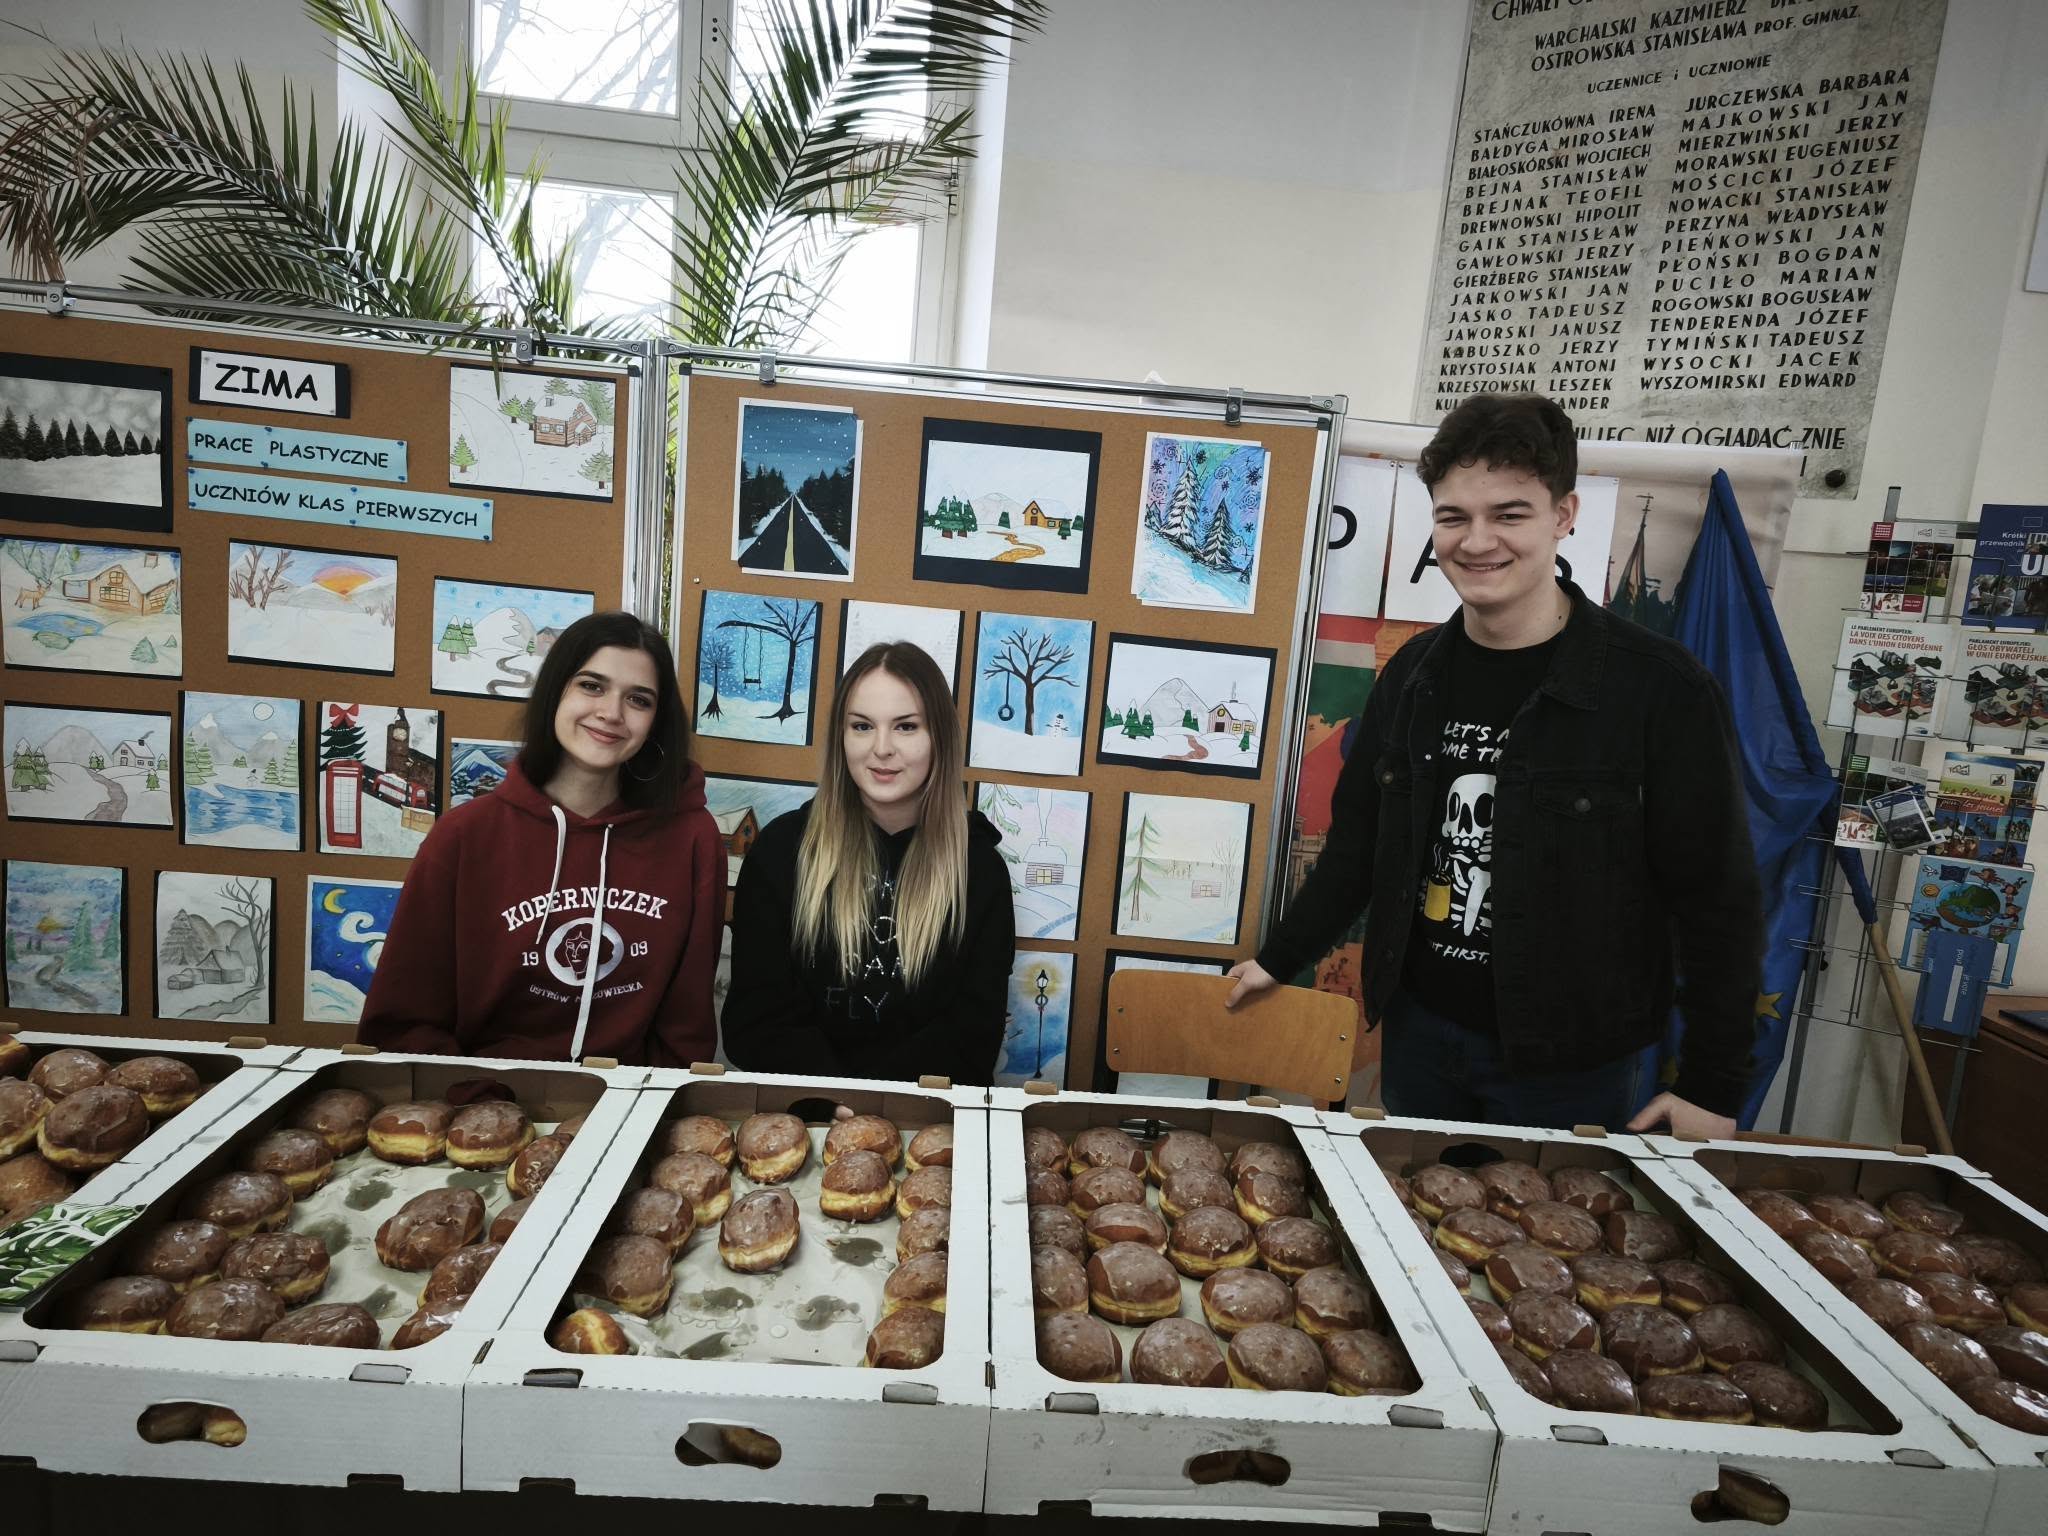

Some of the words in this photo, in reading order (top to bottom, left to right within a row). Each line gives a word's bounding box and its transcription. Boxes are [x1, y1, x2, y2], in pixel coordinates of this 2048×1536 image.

[1531, 39, 1634, 71] OSTROWSKA
[1643, 20, 1747, 53] STANISŁAWA
[1754, 17, 1796, 34] PROF.
[1802, 5, 1861, 26] GIMNAZ.
[1535, 16, 1637, 50] WARCHALSKI
[1650, 0, 1747, 30] KAZIMIERZ
[1588, 71, 1662, 93] UCZENNICE
[1689, 54, 1772, 77] UCZNIOWIE
[1685, 83, 1804, 112] JURCZEWSKA
[1819, 67, 1910, 94] BARBARA
[1474, 113, 1595, 144] STAŃCZUKÓWNA
[1609, 104, 1656, 123] IRENA
[1681, 100, 1829, 132] MAJKOWSKI
[1858, 90, 1908, 110] JAN
[1471, 139, 1548, 162] BAŁDYGA
[1559, 124, 1655, 149] MIROSŁAW
[1678, 123, 1809, 153] MIERZWIŃSKI
[1835, 112, 1904, 134] JERZY
[1468, 155, 1569, 181] BIAŁOSKÓRSKI
[1576, 143, 1652, 166] WOJCIECH
[1674, 148, 1777, 173] MORAWSKI
[1785, 134, 1900, 161] EUGENIUSZ
[1466, 180, 1521, 198] BEJNA
[1540, 164, 1648, 189] STANISŁAW
[1671, 167, 1792, 194] MOŚCICKI
[1812, 156, 1897, 179] JÓZEF
[1463, 195, 1549, 217] BREJNAK
[1566, 184, 1643, 205] TEOFIL
[1668, 191, 1761, 214] NOWACKI
[1775, 178, 1892, 204] STANISŁAW
[1460, 212, 1562, 235] DREWNOWSKI
[1576, 204, 1641, 223] HIPOLIT
[1665, 213, 1749, 234] PERZYNA
[1767, 200, 1888, 225] WŁADYSŁAW
[1459, 236, 1506, 252] GAIK
[1517, 223, 1638, 247] STANISŁAW
[1662, 227, 1813, 254] PIEŃKOWSKI
[1836, 221, 1885, 240] JAN
[1456, 249, 1563, 270] GAWŁOWSKI
[1575, 243, 1634, 261] JERZY
[1658, 252, 1760, 274] PŁOŃSKI
[1778, 244, 1880, 265] BOGDAN
[1548, 263, 1632, 282] STANISŁAW
[1654, 274, 1755, 293] PUCIŁO
[1780, 265, 1877, 285] MARIAN
[1450, 286, 1567, 307] JARKOWSKI
[1587, 282, 1628, 297] JAN
[1651, 293, 1754, 313] ROGOWSKI
[1761, 287, 1873, 307] BOGUSŁAW
[1448, 308, 1512, 324] JASKO
[1528, 301, 1625, 320] TADEUSZ
[1650, 312, 1780, 333] TENDERENDA
[1795, 307, 1869, 326] JÓZEF
[1445, 325, 1535, 341] JAWORSKI
[1550, 320, 1621, 337] JANUSZ
[1646, 331, 1759, 352] TYMIŃSKI
[1769, 329, 1865, 348] TADEUSZ
[1559, 340, 1619, 355] JERZY
[1643, 354, 1752, 371] WYSOCKI
[1776, 351, 1862, 368] JACEK
[1440, 362, 1536, 376] KRYSTOSIAK
[1551, 358, 1616, 373] ANTONI
[1640, 373, 1766, 390] WYSZOMIRSKI
[1778, 372, 1857, 389] EDWARD
[215, 363, 318, 402] ZIMA
[1438, 379, 1535, 394] KRZESZOWSKI
[1549, 378, 1613, 391] LESZEK
[194, 432, 253, 454] PRACE
[270, 440, 389, 469] PLASTYCZNE
[194, 482, 291, 506] UCZNIÓW
[298, 494, 345, 512] KLAS
[356, 500, 478, 527] PIERWSZYCH
[1849, 638, 1867, 646] DANS
[1861, 631, 1876, 639] VOIX
[1878, 633, 1890, 641] DES
[1892, 634, 1925, 643] CITOYENS
[1990, 645, 2035, 654] OBYWATELI
[1444, 720, 1492, 741] LET'S
[521, 951, 539, 966] 19
[630, 940, 648, 957] 09
